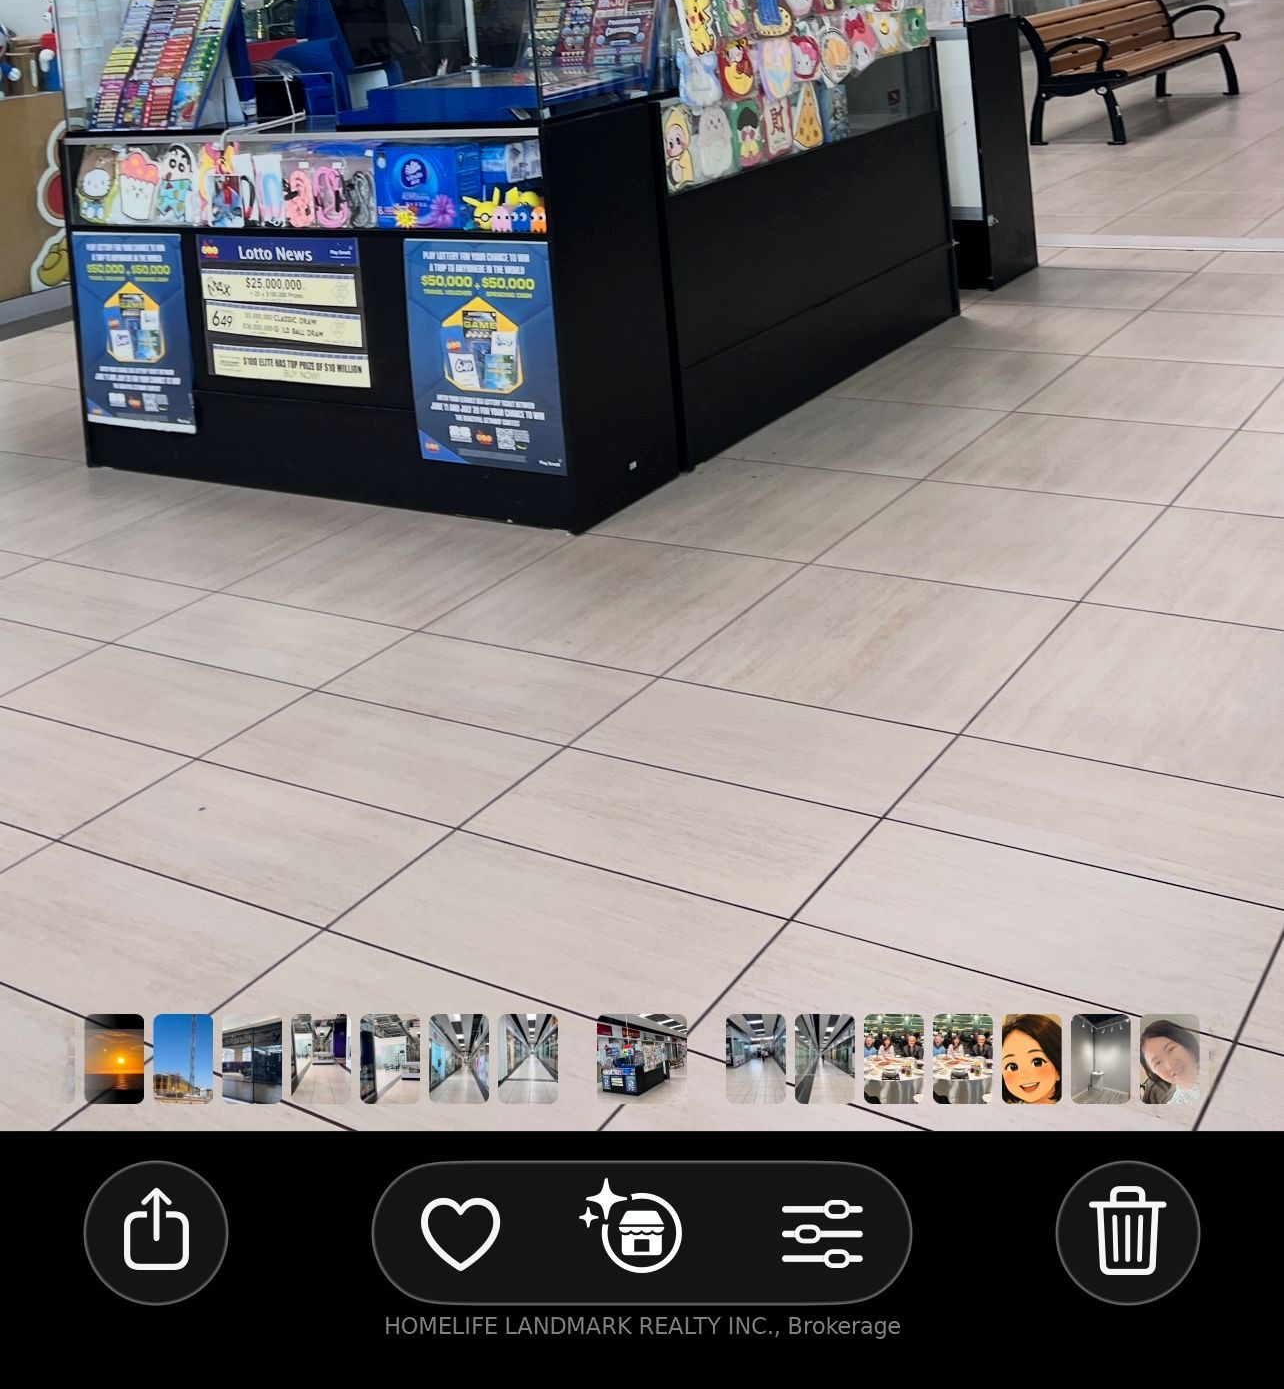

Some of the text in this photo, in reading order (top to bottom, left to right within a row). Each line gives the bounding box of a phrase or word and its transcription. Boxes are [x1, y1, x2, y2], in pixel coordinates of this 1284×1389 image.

[238, 245, 273, 261] Lotto
[275, 246, 313, 262] News
[421, 275, 473, 288] $50,000
[481, 276, 536, 291] $50,000
[464, 321, 497, 330] GAME
